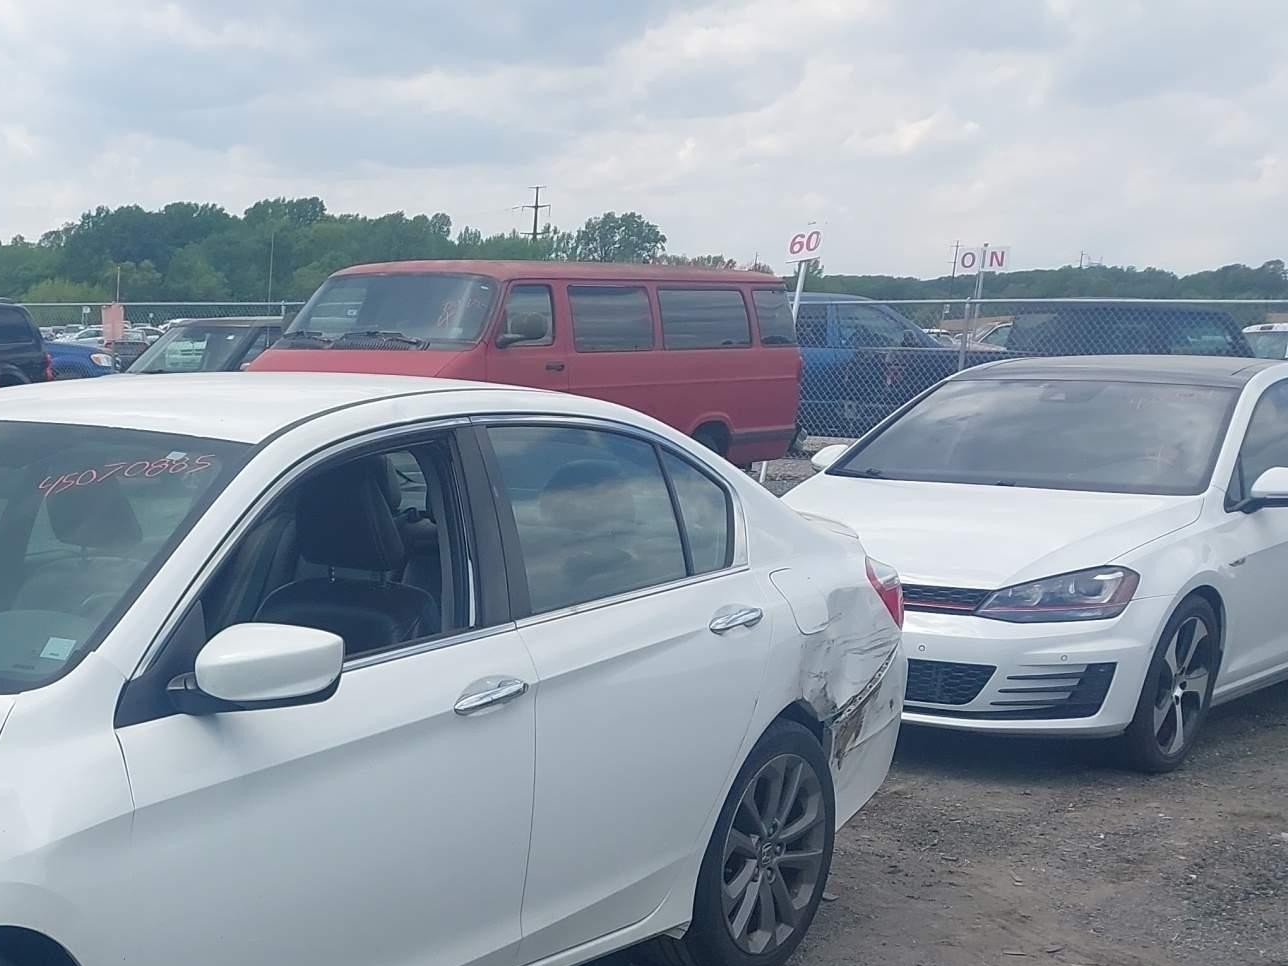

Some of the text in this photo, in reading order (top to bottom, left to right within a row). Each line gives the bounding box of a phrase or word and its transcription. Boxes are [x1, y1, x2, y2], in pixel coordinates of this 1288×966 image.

[790, 231, 821, 254] 60
[961, 251, 1005, 268] O N
[39, 455, 215, 496] 45070885
